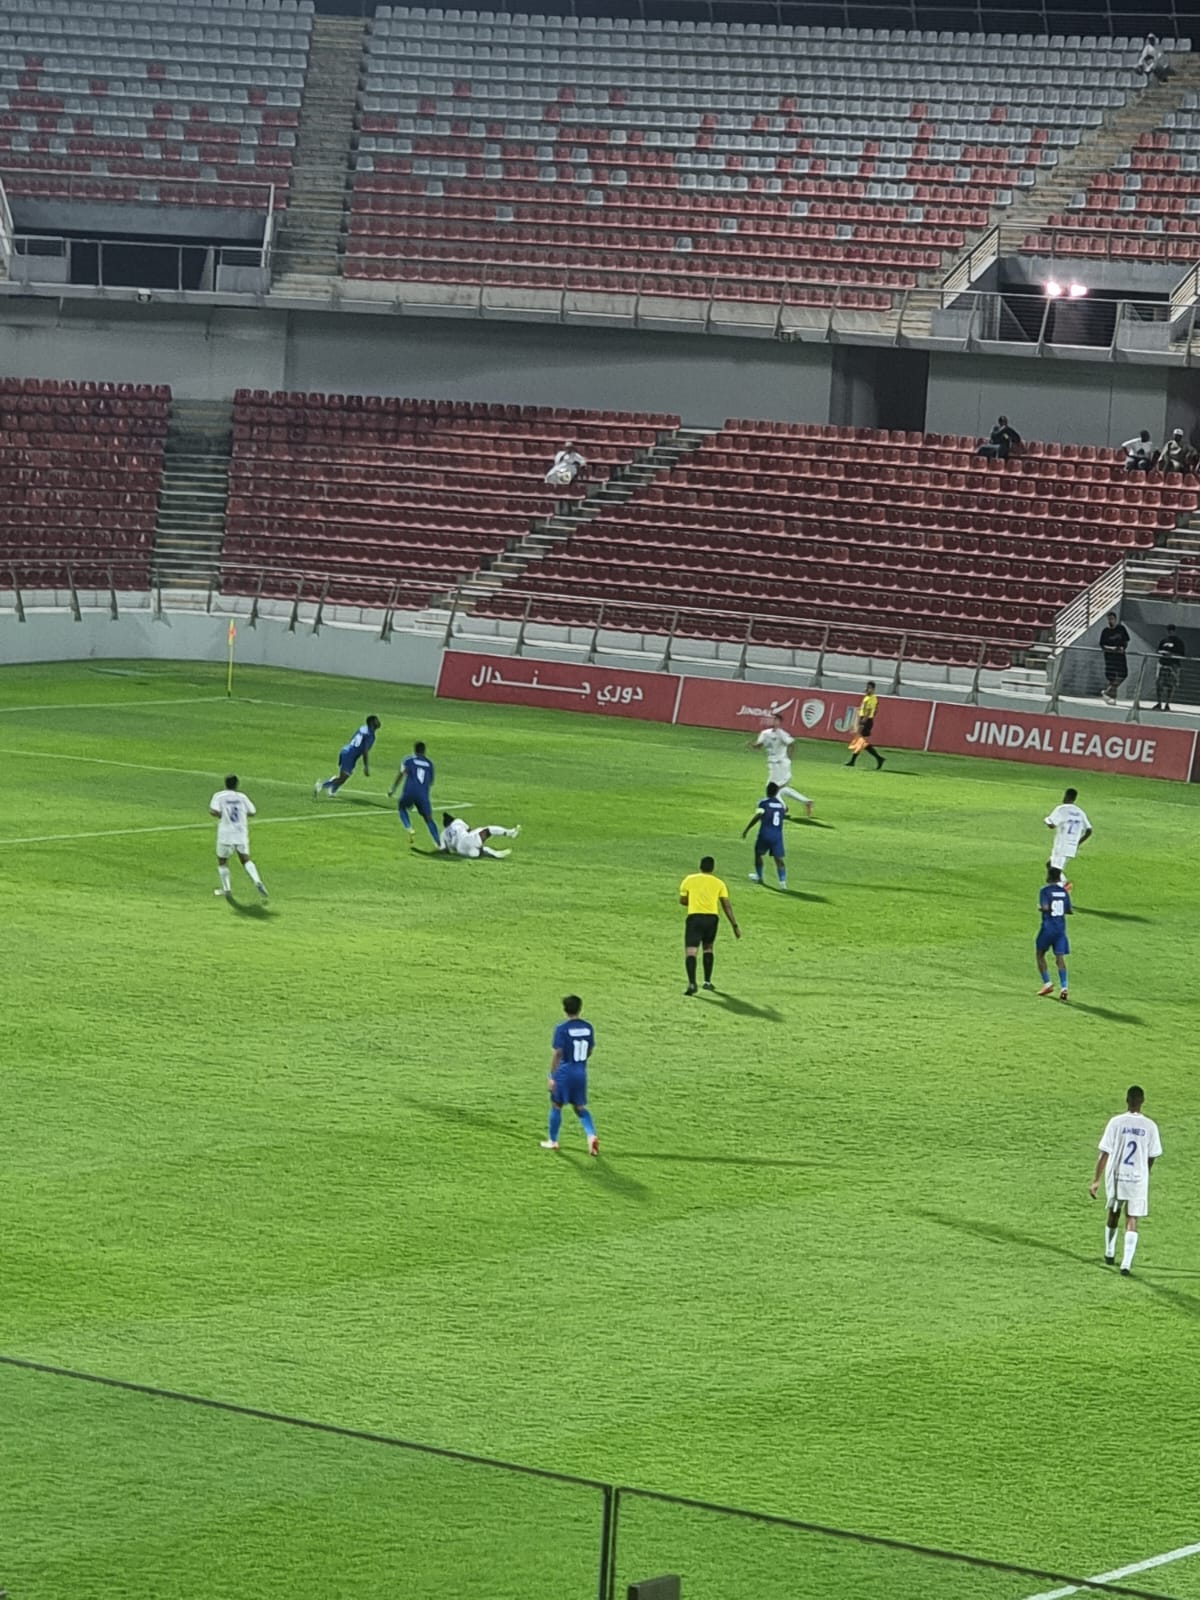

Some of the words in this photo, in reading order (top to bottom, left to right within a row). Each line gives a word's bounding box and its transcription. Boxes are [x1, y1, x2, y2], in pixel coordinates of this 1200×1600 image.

[596, 684, 643, 706] دوري
[965, 720, 1054, 752] JINDAL
[1059, 731, 1157, 763] LEAGUE
[1122, 1127, 1146, 1136] AHMED
[1123, 1140, 1137, 1166] 2
